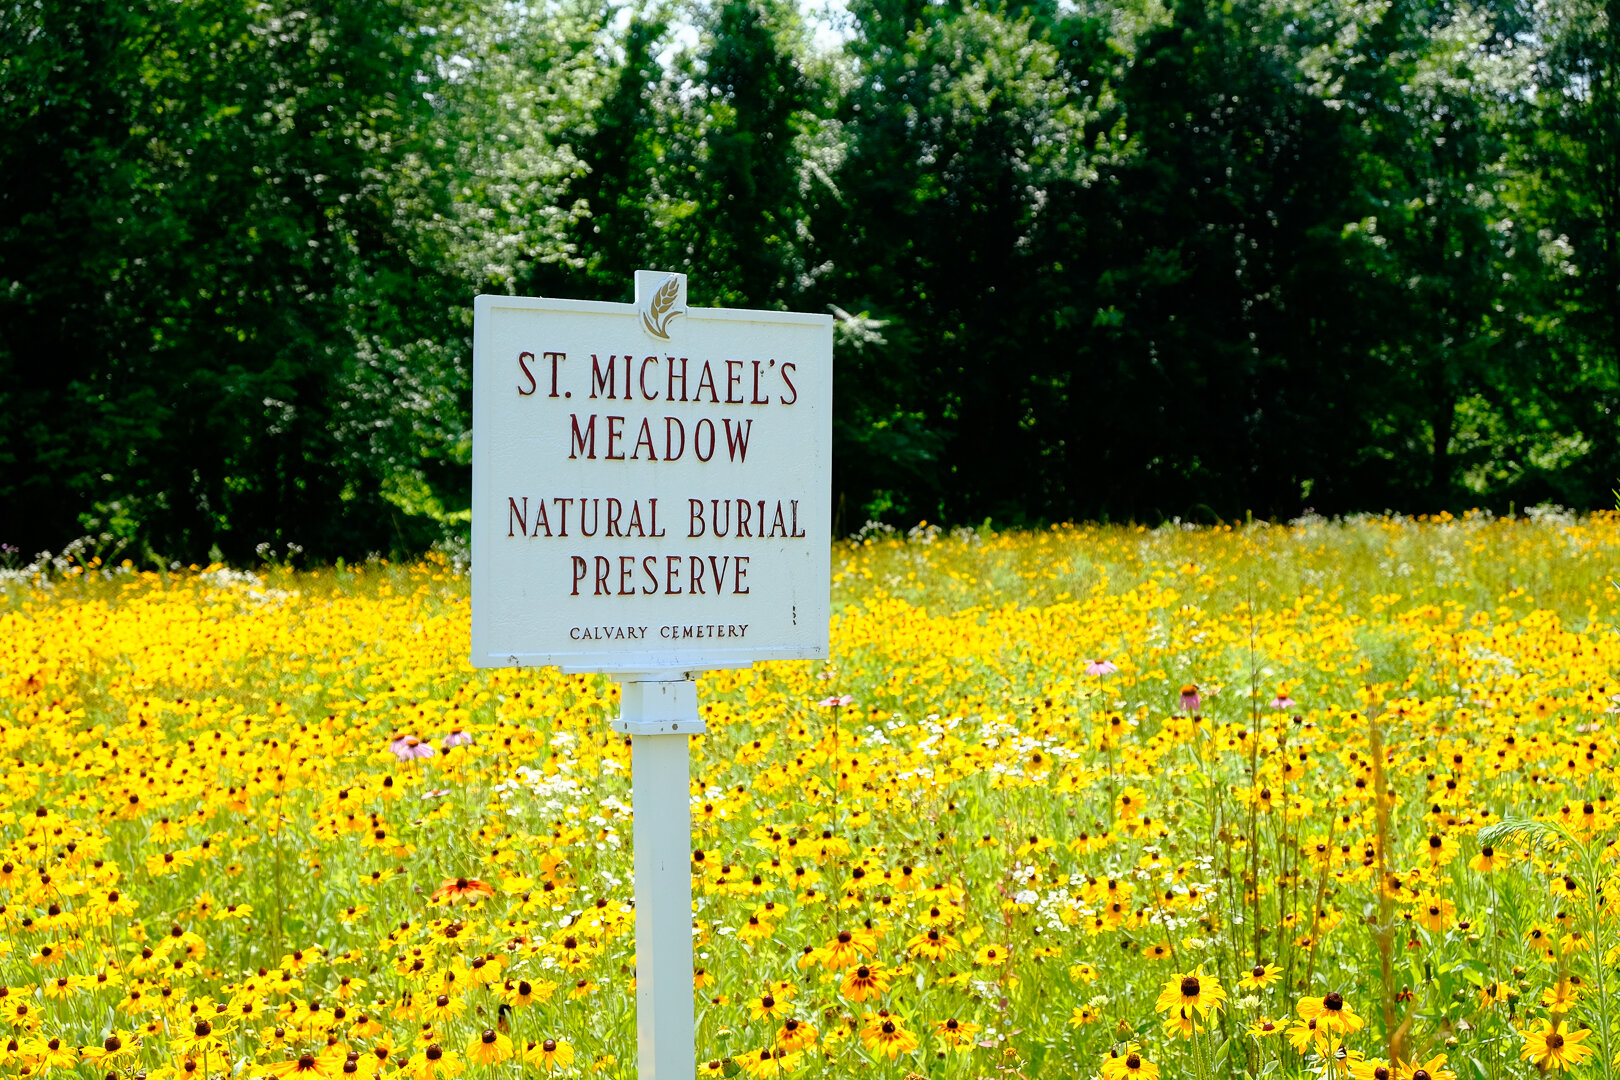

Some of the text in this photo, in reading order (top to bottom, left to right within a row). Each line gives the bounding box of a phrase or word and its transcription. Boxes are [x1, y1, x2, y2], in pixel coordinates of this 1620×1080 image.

[517, 352, 798, 405] ST. MICHAEL'S
[568, 413, 753, 463] MEADOW
[507, 497, 806, 538] NATURAL BURIAL
[570, 556, 750, 596] PRESERVE
[569, 624, 749, 641] CALVARY CEMETERY
